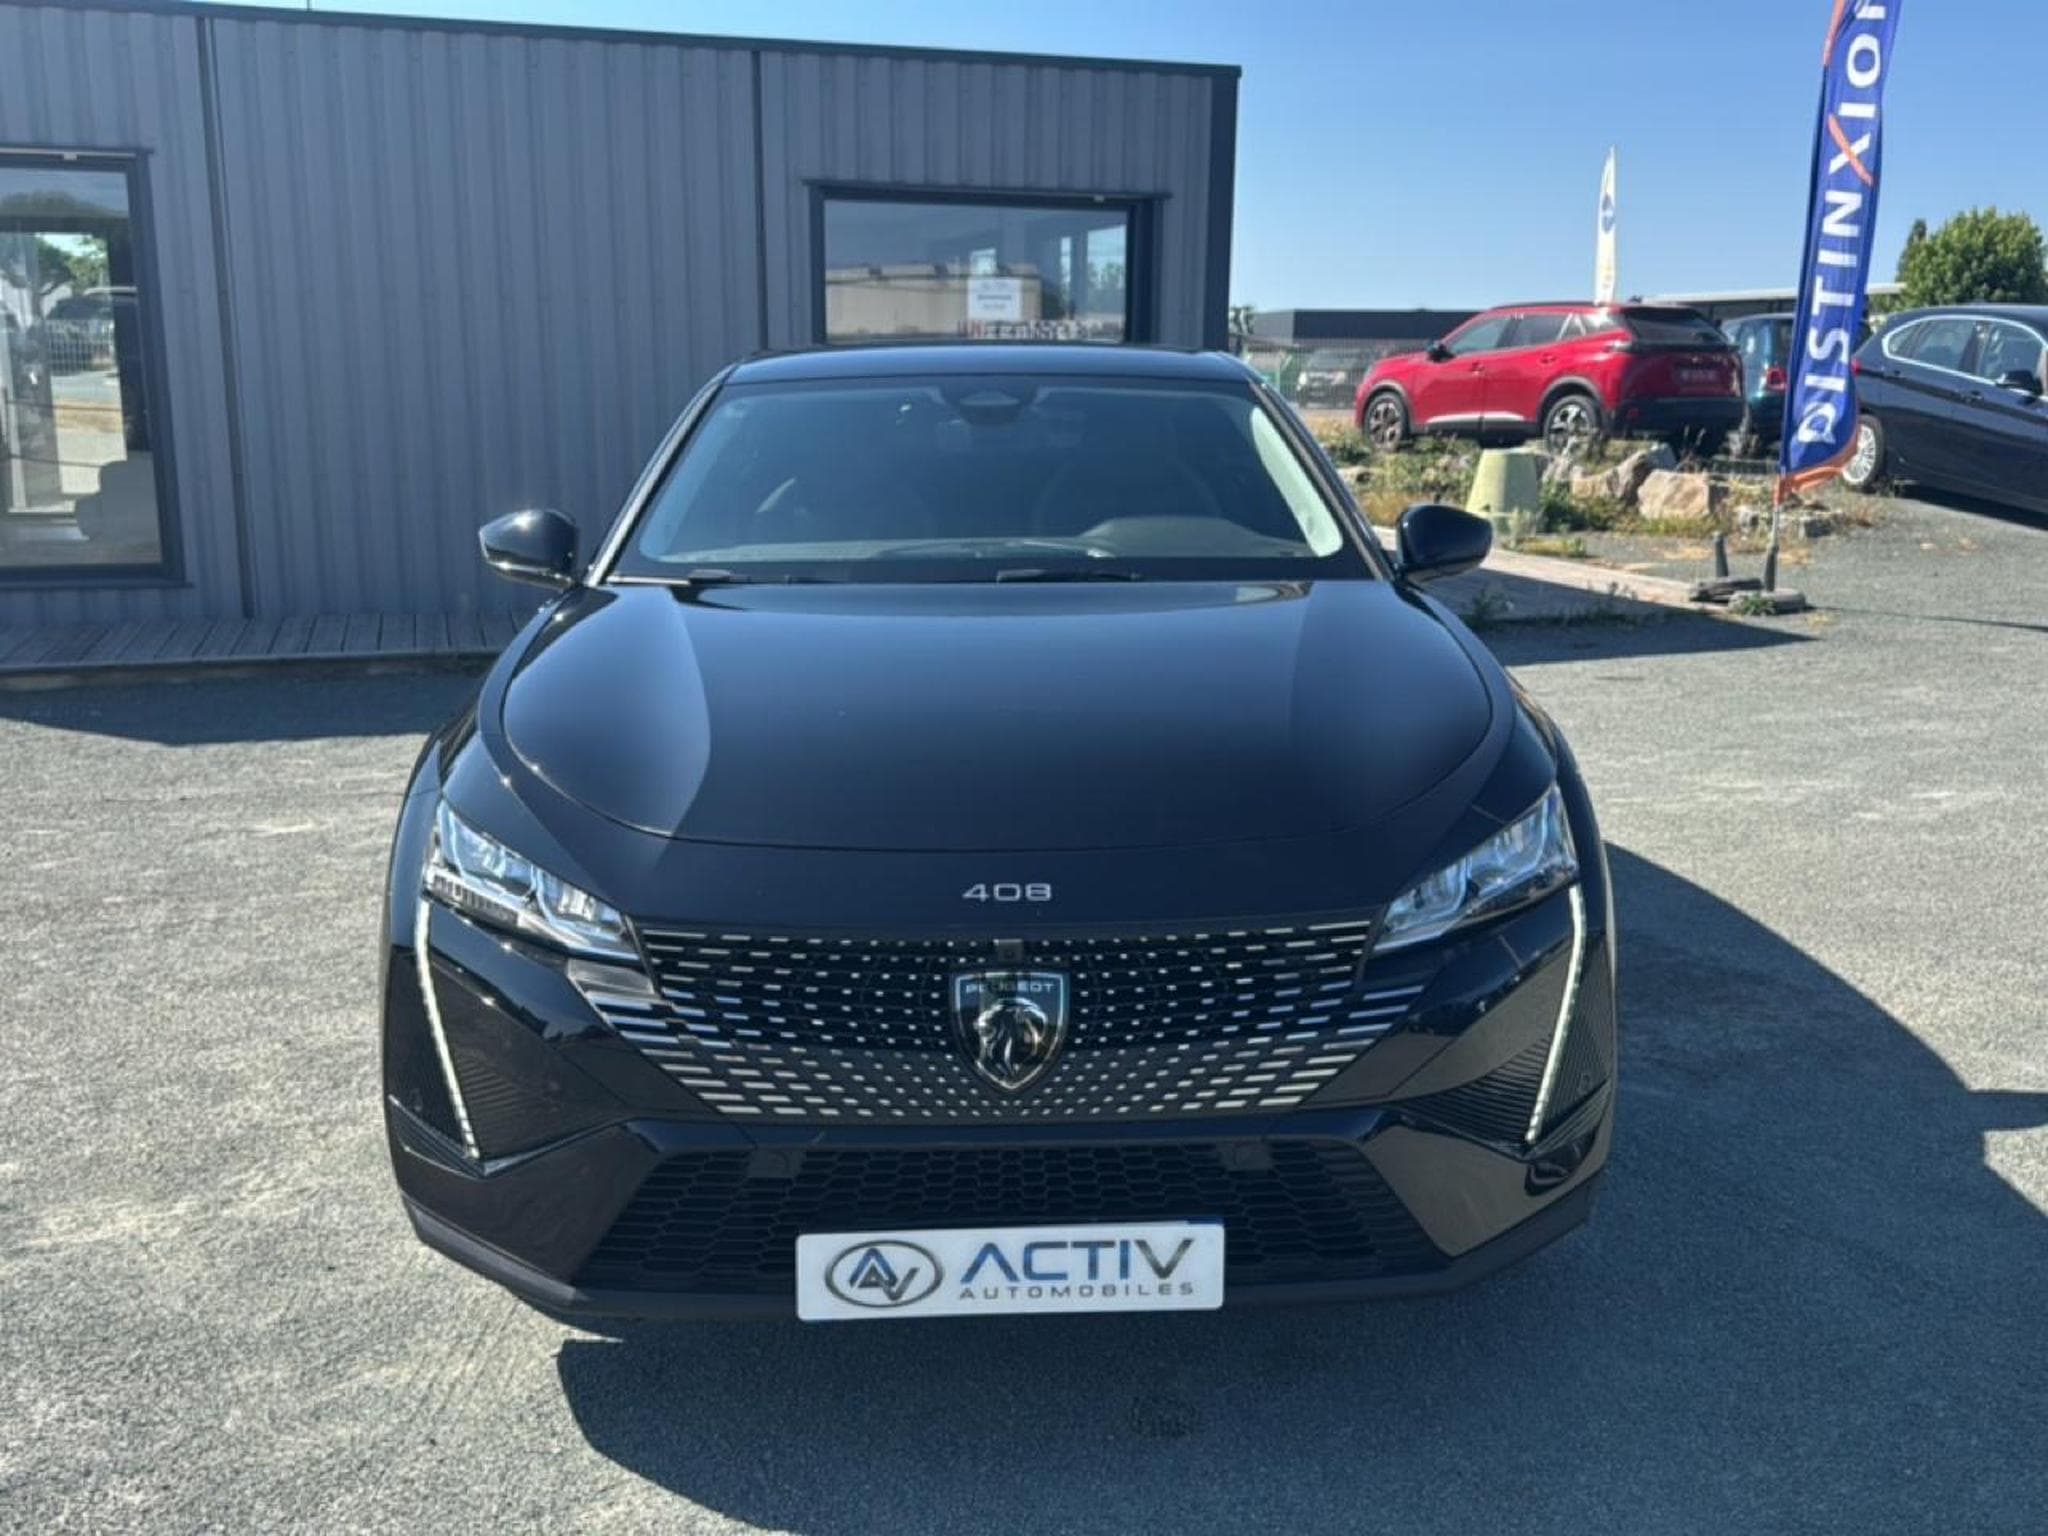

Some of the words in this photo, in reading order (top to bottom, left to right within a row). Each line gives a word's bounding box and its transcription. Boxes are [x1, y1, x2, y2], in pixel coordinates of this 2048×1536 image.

[962, 883, 1052, 901] 408
[965, 980, 1054, 994] PEEOT
[960, 1238, 1195, 1283] ACTIV
[960, 1282, 1194, 1301] AUTOMOBILES
